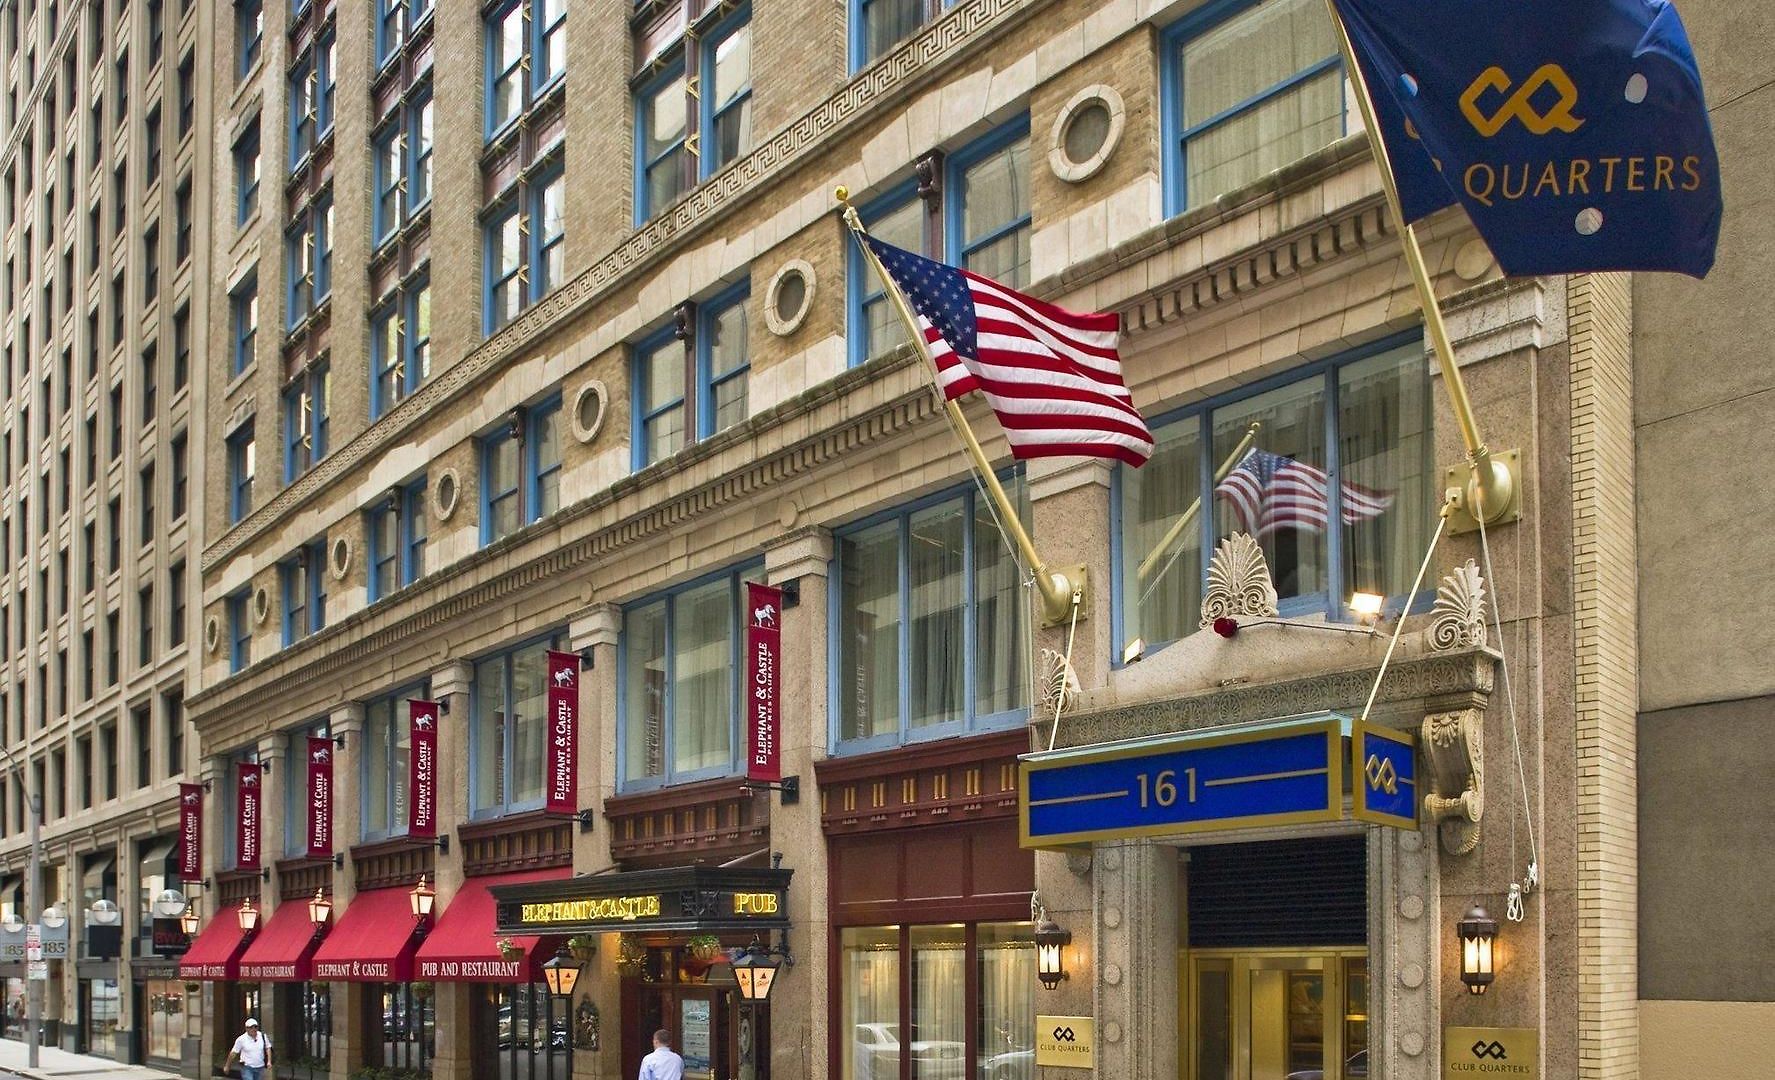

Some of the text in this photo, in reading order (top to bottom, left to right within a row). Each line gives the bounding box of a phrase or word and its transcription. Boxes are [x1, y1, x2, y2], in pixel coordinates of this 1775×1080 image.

[1464, 156, 1700, 207] QUARTERS
[756, 642, 768, 765] ELEPHANT & CASTLE
[555, 699, 567, 801] ELEPHANT & CASTLE
[416, 740, 428, 826] ELEPHANT & CASTLE
[1137, 767, 1197, 808] 161
[314, 772, 323, 848] ELEPHANT & CASTLE
[243, 818, 251, 826] &
[734, 893, 778, 914] PUB
[42, 941, 66, 954] 185
[202, 964, 209, 977] &
[240, 965, 296, 977] PUB AND RESTAURANT
[318, 961, 388, 977] ELEPHANT & CASTLE
[422, 961, 520, 977] PUB AND RESTAURANT
[1058, 1044, 1090, 1053] QUARTERS
[1451, 1062, 1530, 1074] CLUB QUARTERS
